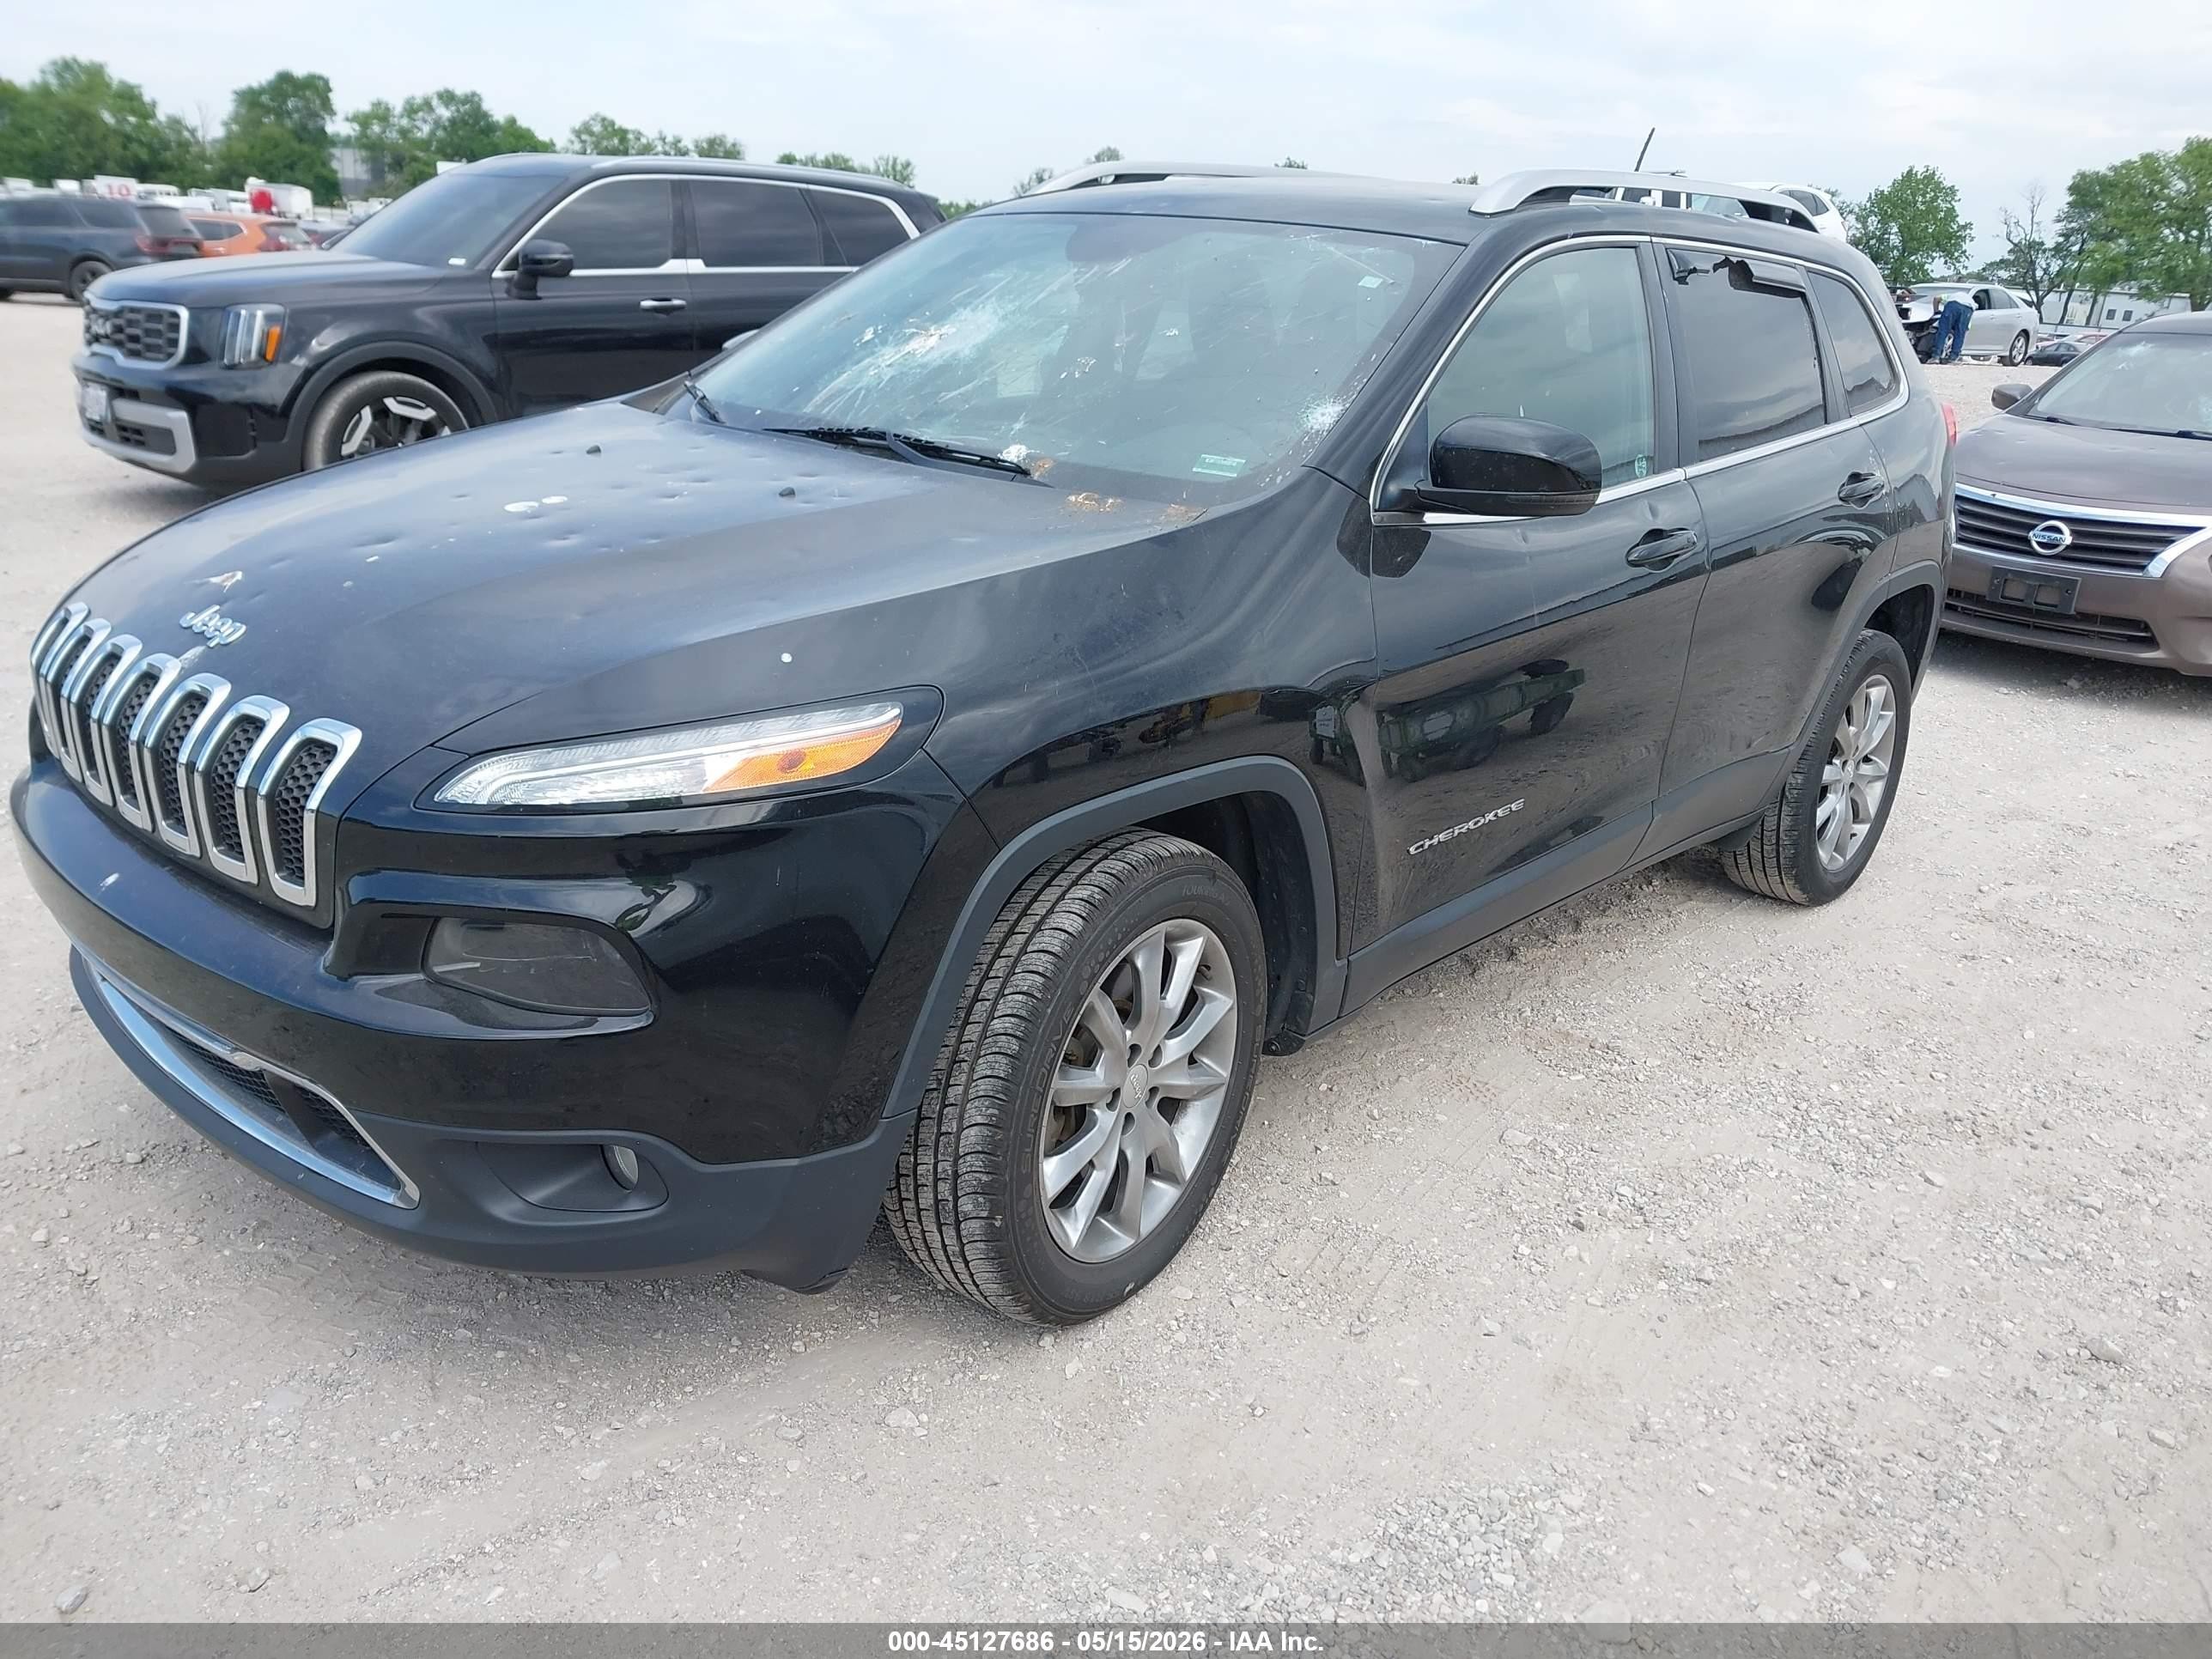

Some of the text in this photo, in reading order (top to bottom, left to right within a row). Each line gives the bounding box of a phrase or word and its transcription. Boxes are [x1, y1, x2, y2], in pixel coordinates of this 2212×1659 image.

[2032, 532, 2066, 544] NISSAN
[179, 604, 246, 648] Jeep
[1407, 798, 1526, 855] CHEROKEE
[1020, 1001, 1074, 1176] SURE DRIVE
